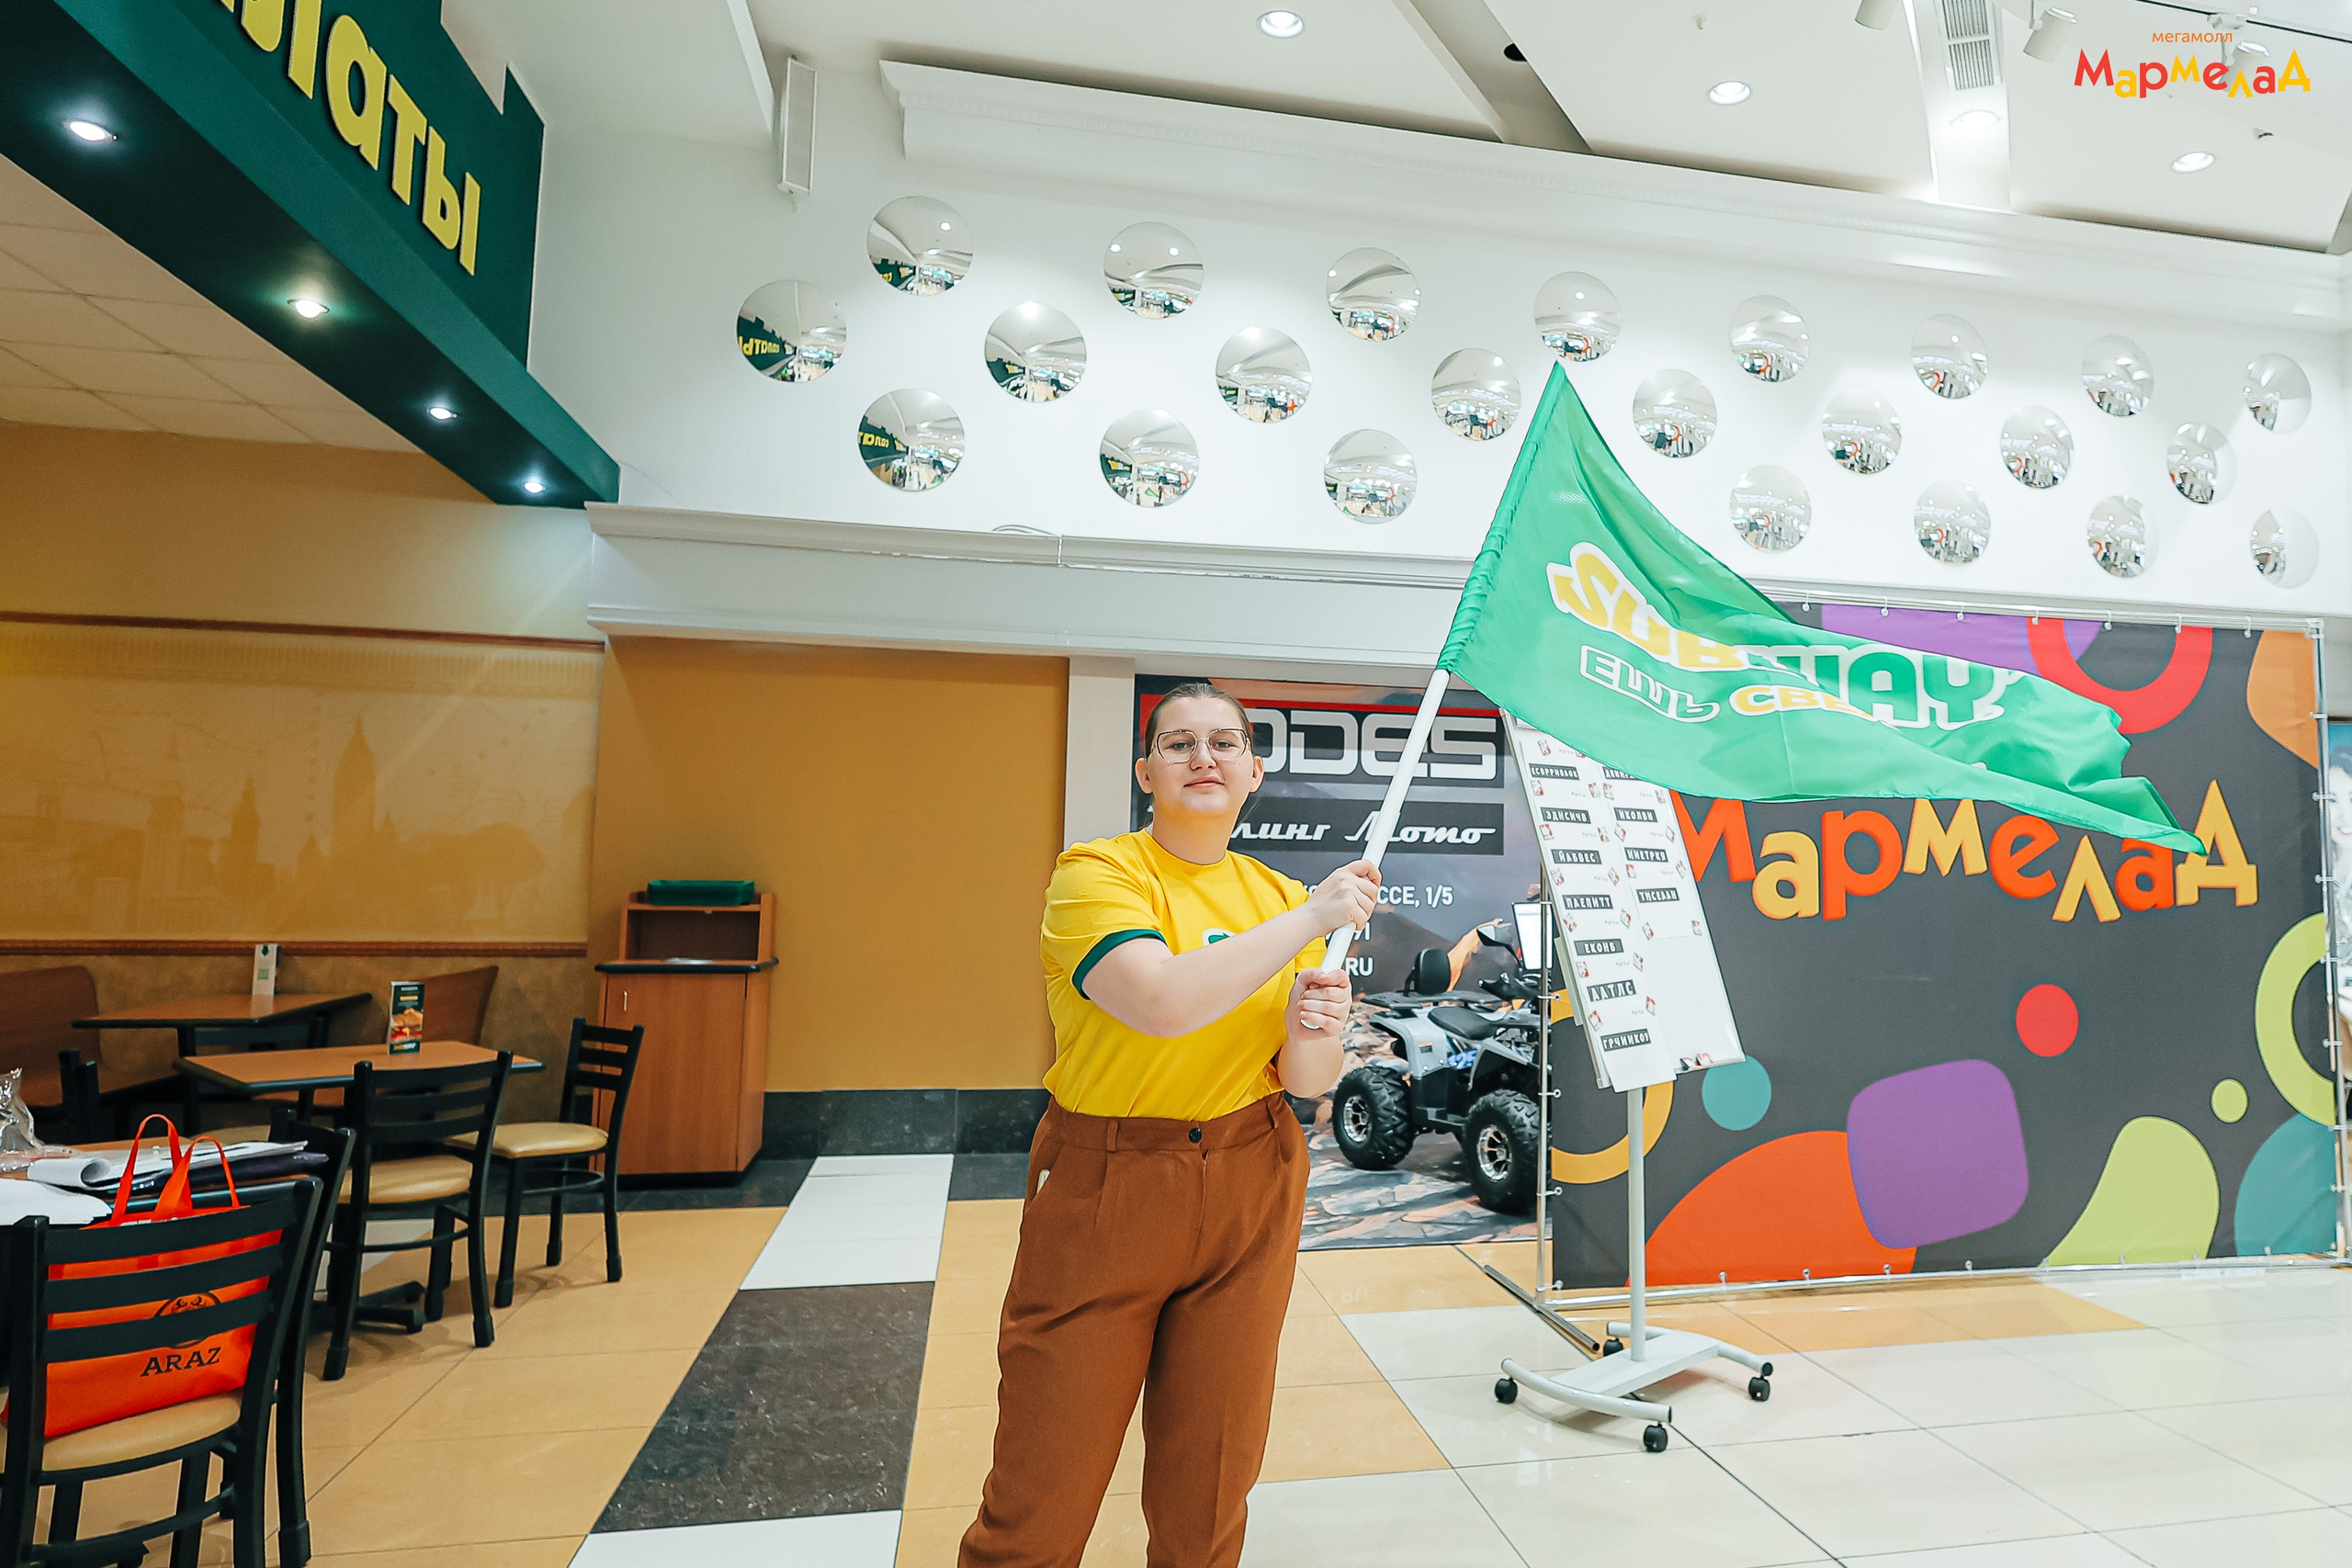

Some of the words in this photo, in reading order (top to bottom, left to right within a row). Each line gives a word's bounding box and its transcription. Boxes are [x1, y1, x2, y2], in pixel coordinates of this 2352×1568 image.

[220, 0, 481, 276] латы
[1729, 685, 1880, 722] СВЕ
[1246, 706, 1497, 781] ODES
[1230, 822, 1331, 842] линг
[1377, 885, 1420, 908] ССЕ,
[1425, 885, 1453, 908] 1/5
[1566, 897, 1611, 908] ПАЕПИТТ
[1584, 942, 1616, 953] ЕКОНБ
[1345, 956, 1374, 976] RU
[1590, 981, 1634, 1001] ААТЛС
[140, 1347, 221, 1377] ARAZ
